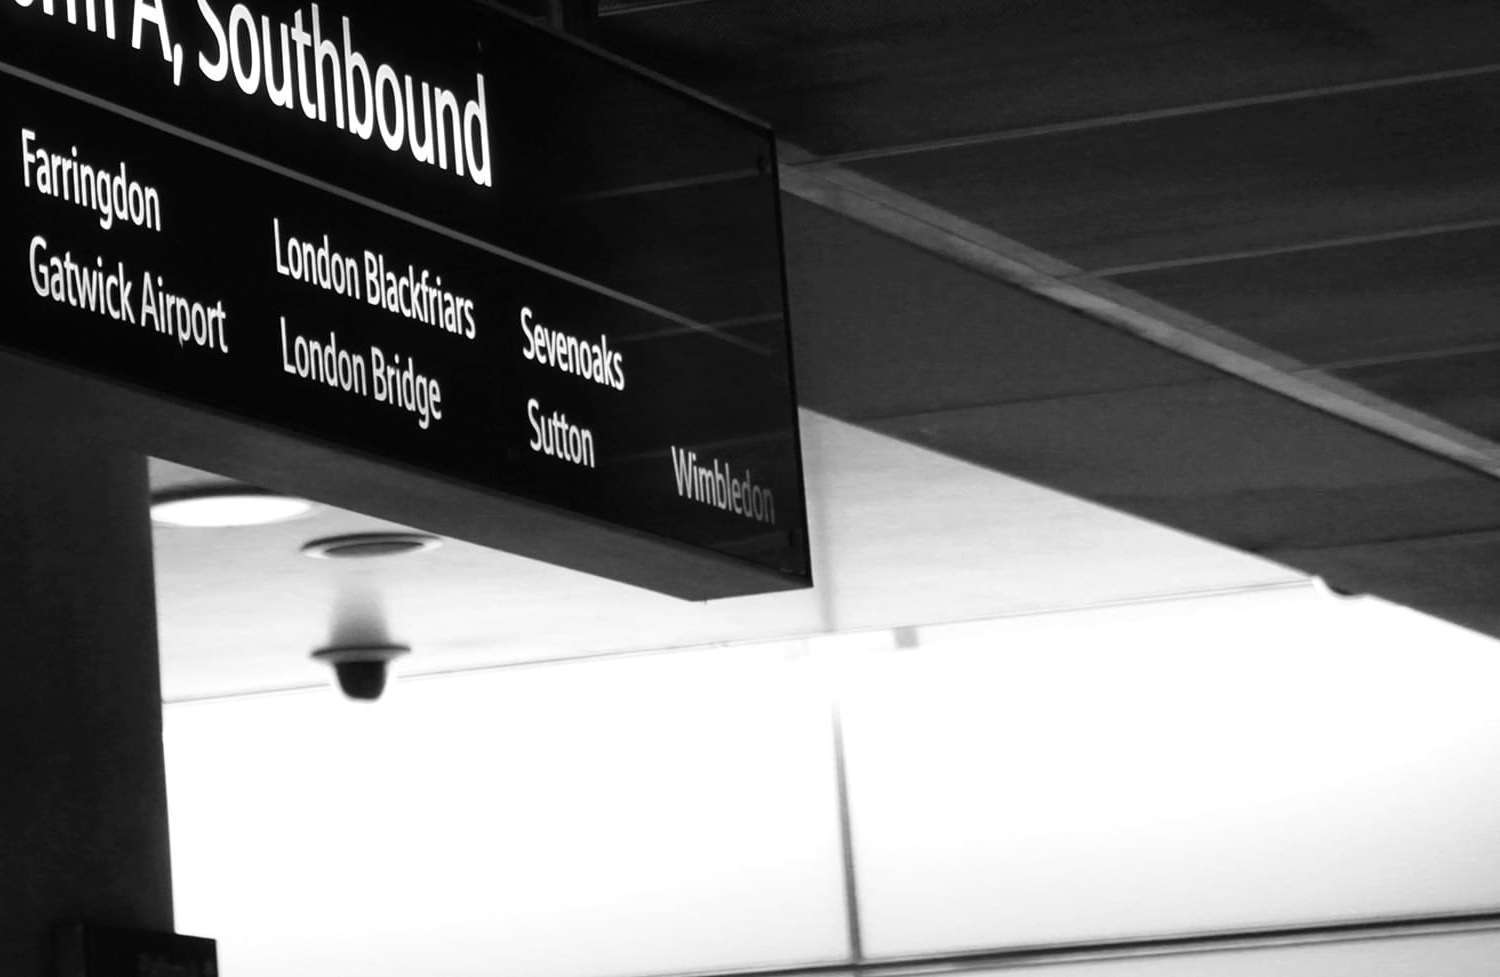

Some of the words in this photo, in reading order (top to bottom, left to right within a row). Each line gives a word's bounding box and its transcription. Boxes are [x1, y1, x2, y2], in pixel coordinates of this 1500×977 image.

[20, 127, 162, 232] Farringdon
[28, 234, 136, 325] Gatwick
[140, 271, 229, 354] Airport
[273, 217, 361, 300] London
[363, 249, 477, 340] Blackfriars
[279, 315, 368, 397] London
[370, 345, 443, 430] Bridge
[520, 306, 626, 392] Sevenoaks
[527, 397, 596, 469] Sutton
[670, 445, 776, 524] Wimbledon
